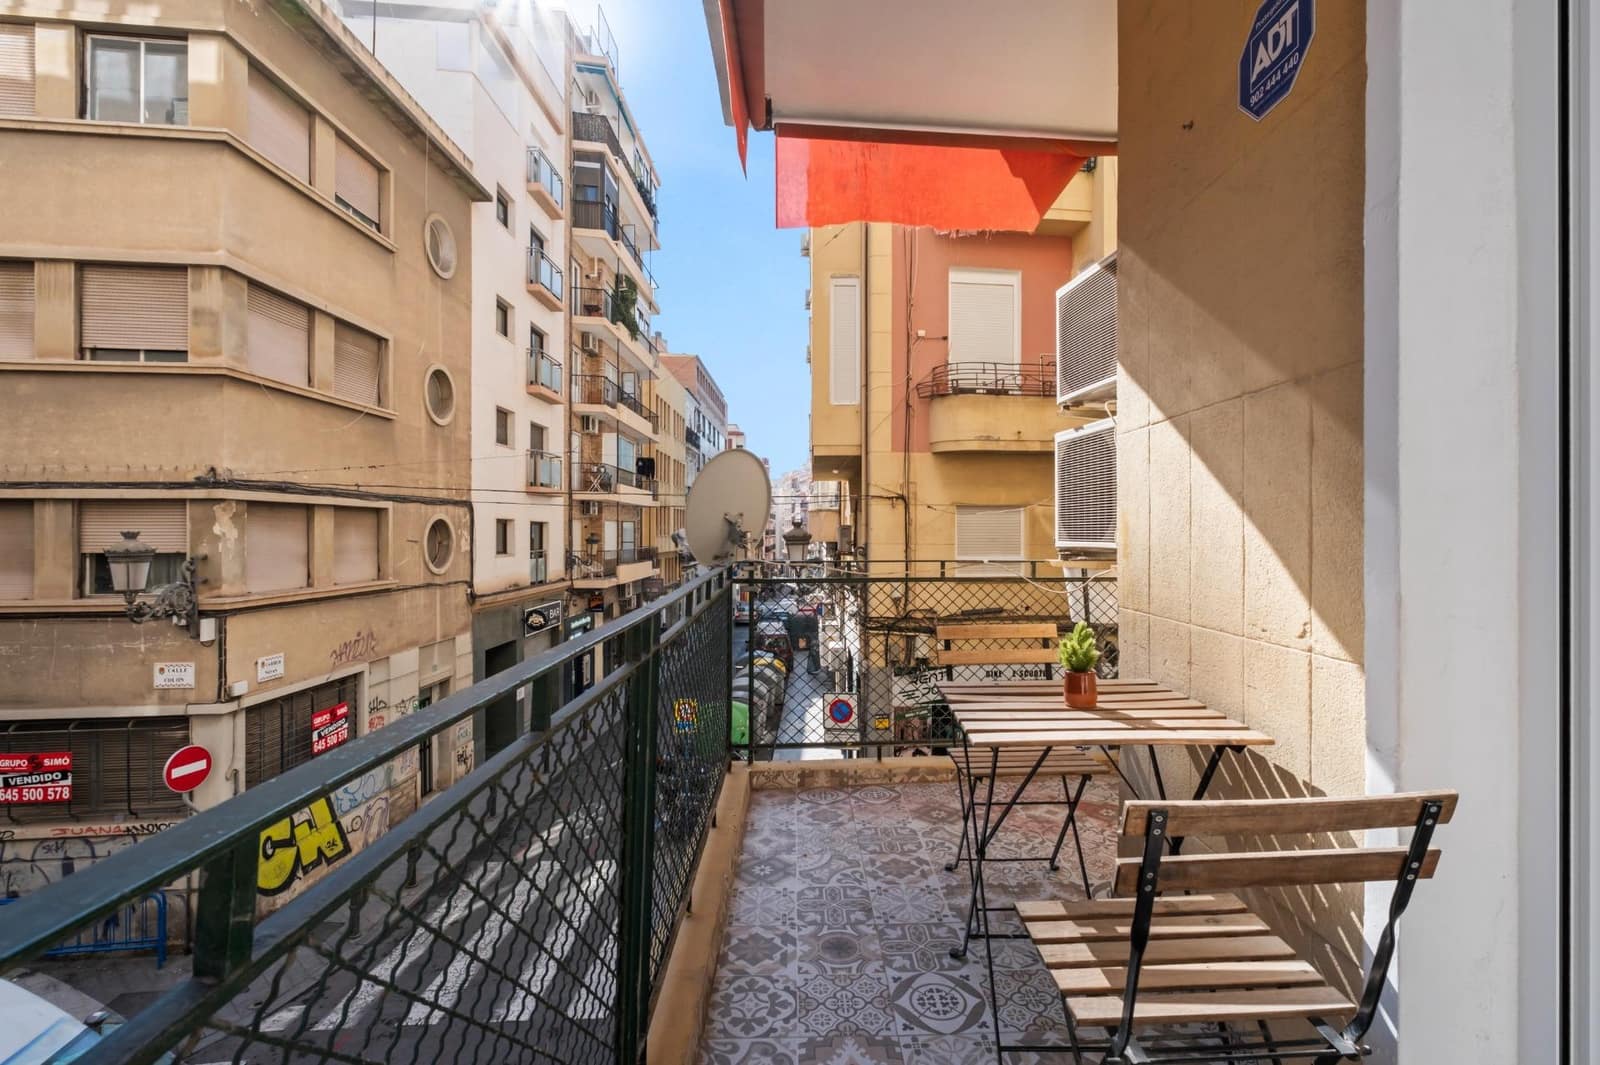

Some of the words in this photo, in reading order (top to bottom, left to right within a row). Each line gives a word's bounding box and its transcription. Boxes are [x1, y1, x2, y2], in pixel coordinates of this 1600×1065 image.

[1252, 1, 1299, 81] ADT
[1250, 86, 1265, 107] 902
[1265, 70, 1282, 91] 444
[1282, 52, 1300, 75] 440
[549, 607, 560, 619] BAR
[320, 718, 346, 737] VENDIDO
[313, 738, 326, 753] 645
[327, 734, 337, 747] 500
[0, 759, 28, 767] GRUPO
[43, 756, 70, 766] SIMÓ
[8, 772, 62, 786] VENDIDO
[0, 788, 19, 801] 645
[22, 788, 44, 801] 500
[47, 787, 70, 800] 578
